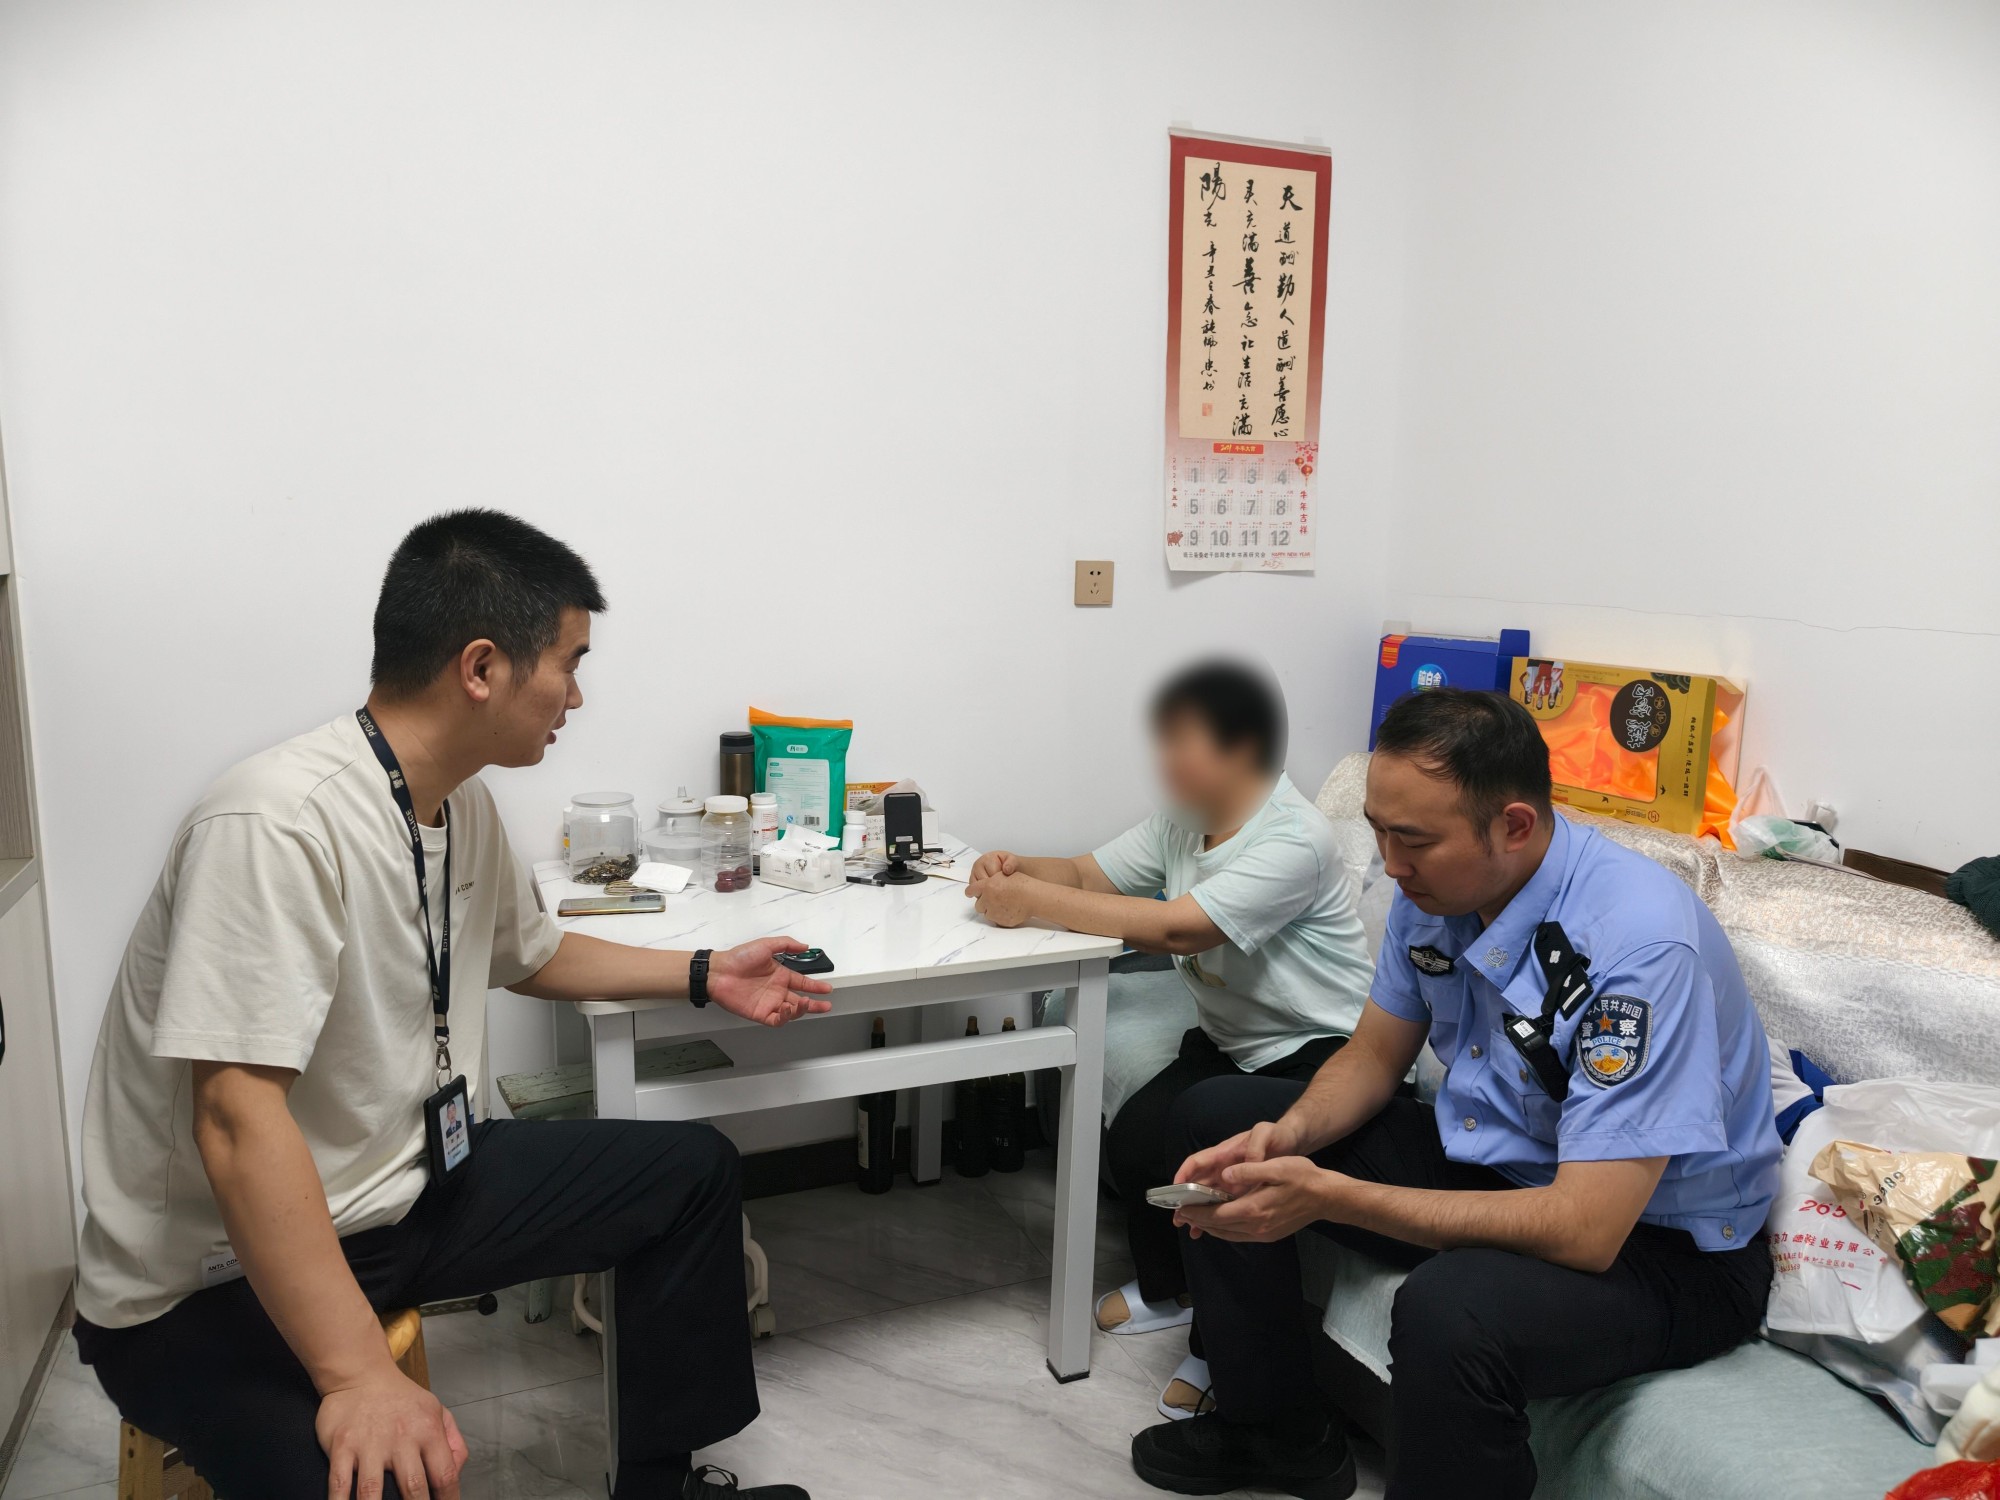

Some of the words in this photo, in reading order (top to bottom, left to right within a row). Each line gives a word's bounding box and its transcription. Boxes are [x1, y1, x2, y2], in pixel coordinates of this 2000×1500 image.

[1191, 467, 1199, 483] 1
[1217, 468, 1227, 484] 2
[1247, 469, 1257, 485] 3
[1277, 470, 1287, 485] 4
[1190, 499, 1199, 515] 5
[1217, 499, 1227, 515] 6
[1246, 499, 1256, 515] 7
[1276, 499, 1286, 516] 8
[1300, 490, 1308, 535] 牛年吉祥
[1190, 530, 1199, 546] 9
[1210, 529, 1229, 546] 10
[1241, 529, 1259, 546] 11
[1270, 529, 1290, 546] 12
[405, 808, 420, 843] POLICE
[1591, 1036, 1623, 1046] POLICE
[208, 1263, 225, 1271] ANTA
